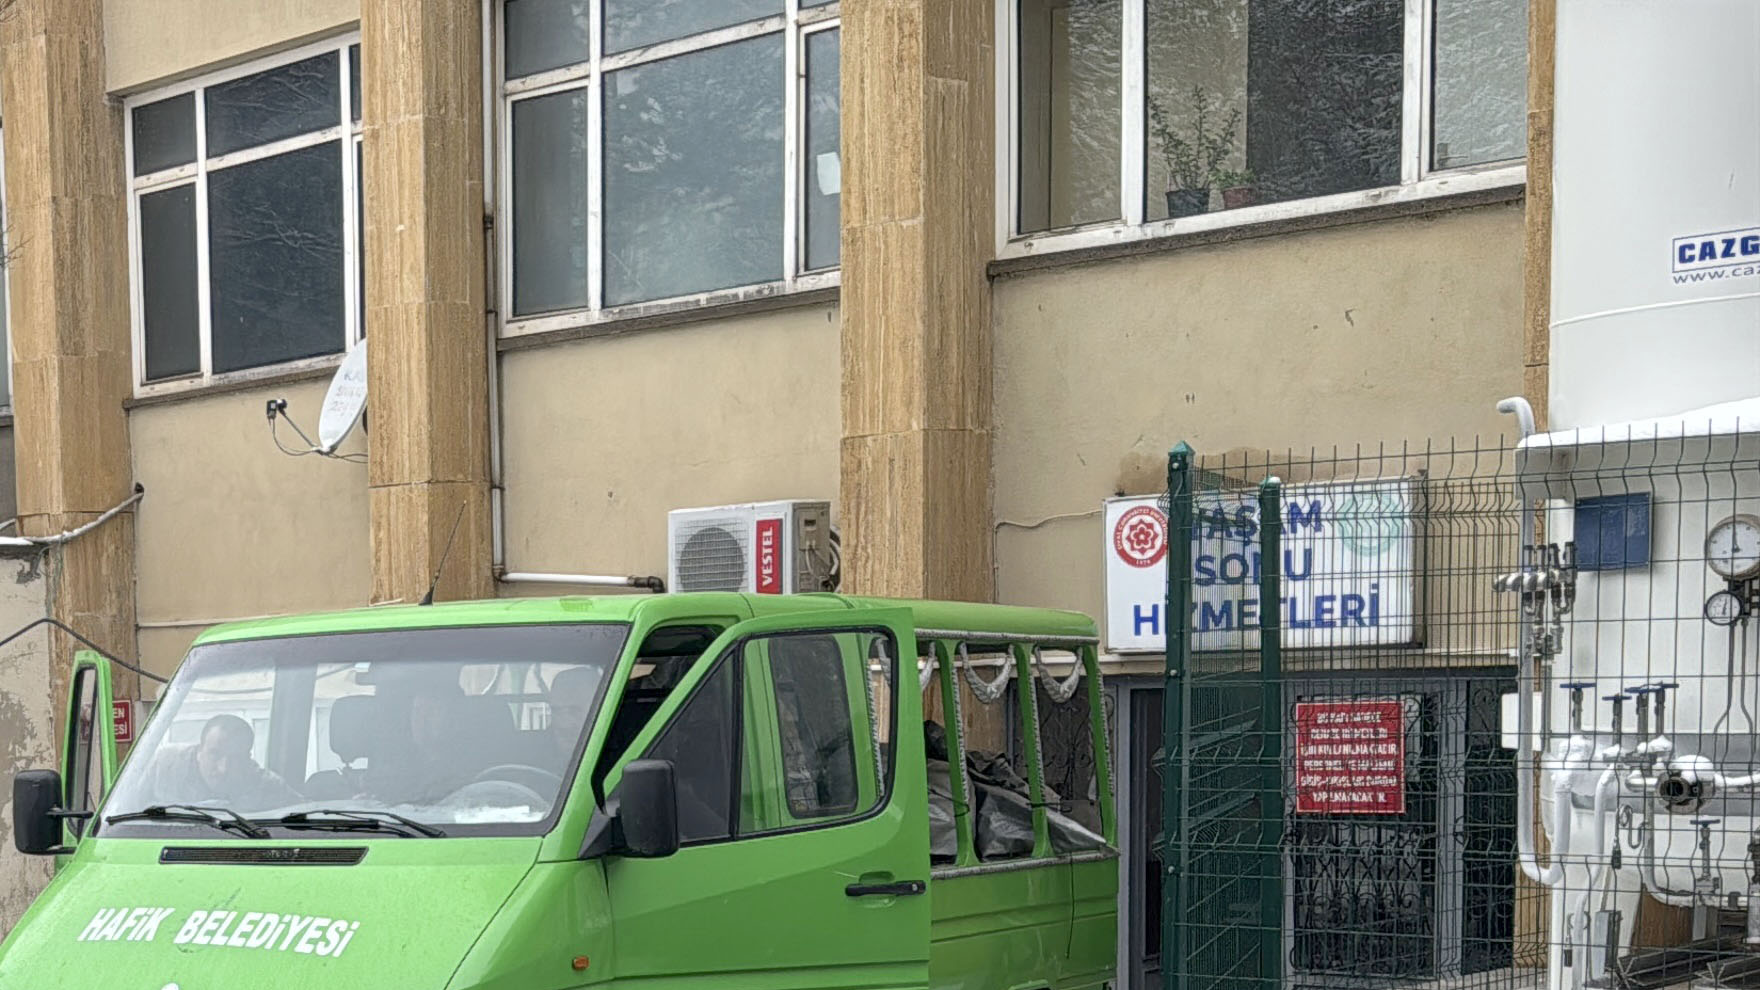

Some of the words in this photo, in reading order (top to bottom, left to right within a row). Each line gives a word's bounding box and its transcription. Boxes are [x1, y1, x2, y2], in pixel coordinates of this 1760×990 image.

[1678, 235, 1760, 264] CAZG
[761, 527, 774, 587] VESTEL
[1133, 584, 1379, 636] HMELERİ
